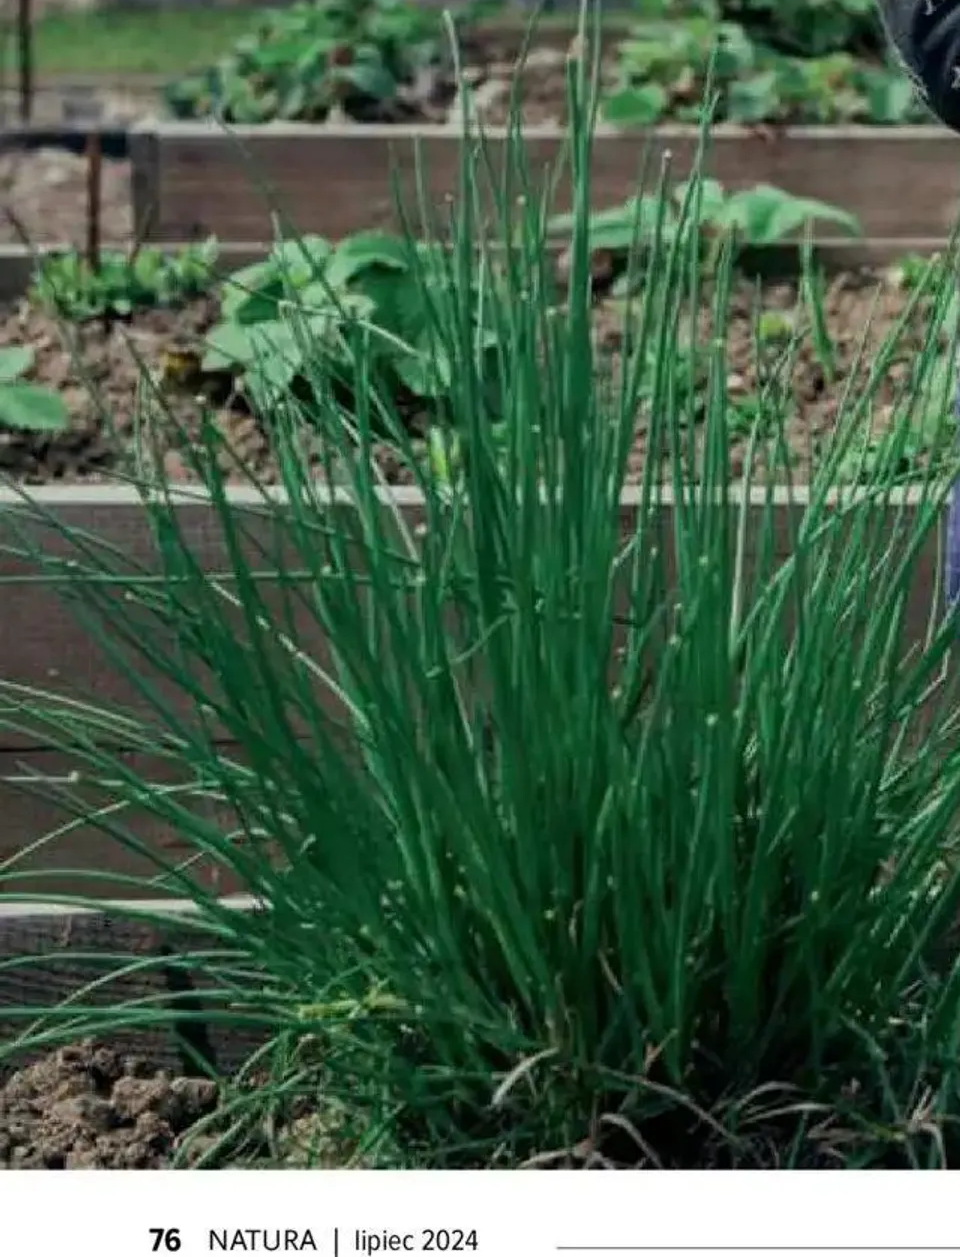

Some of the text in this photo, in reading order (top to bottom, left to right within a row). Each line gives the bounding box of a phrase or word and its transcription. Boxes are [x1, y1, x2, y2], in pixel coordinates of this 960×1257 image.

[148, 1227, 479, 1256] 76 NATURA lipiec 2024
